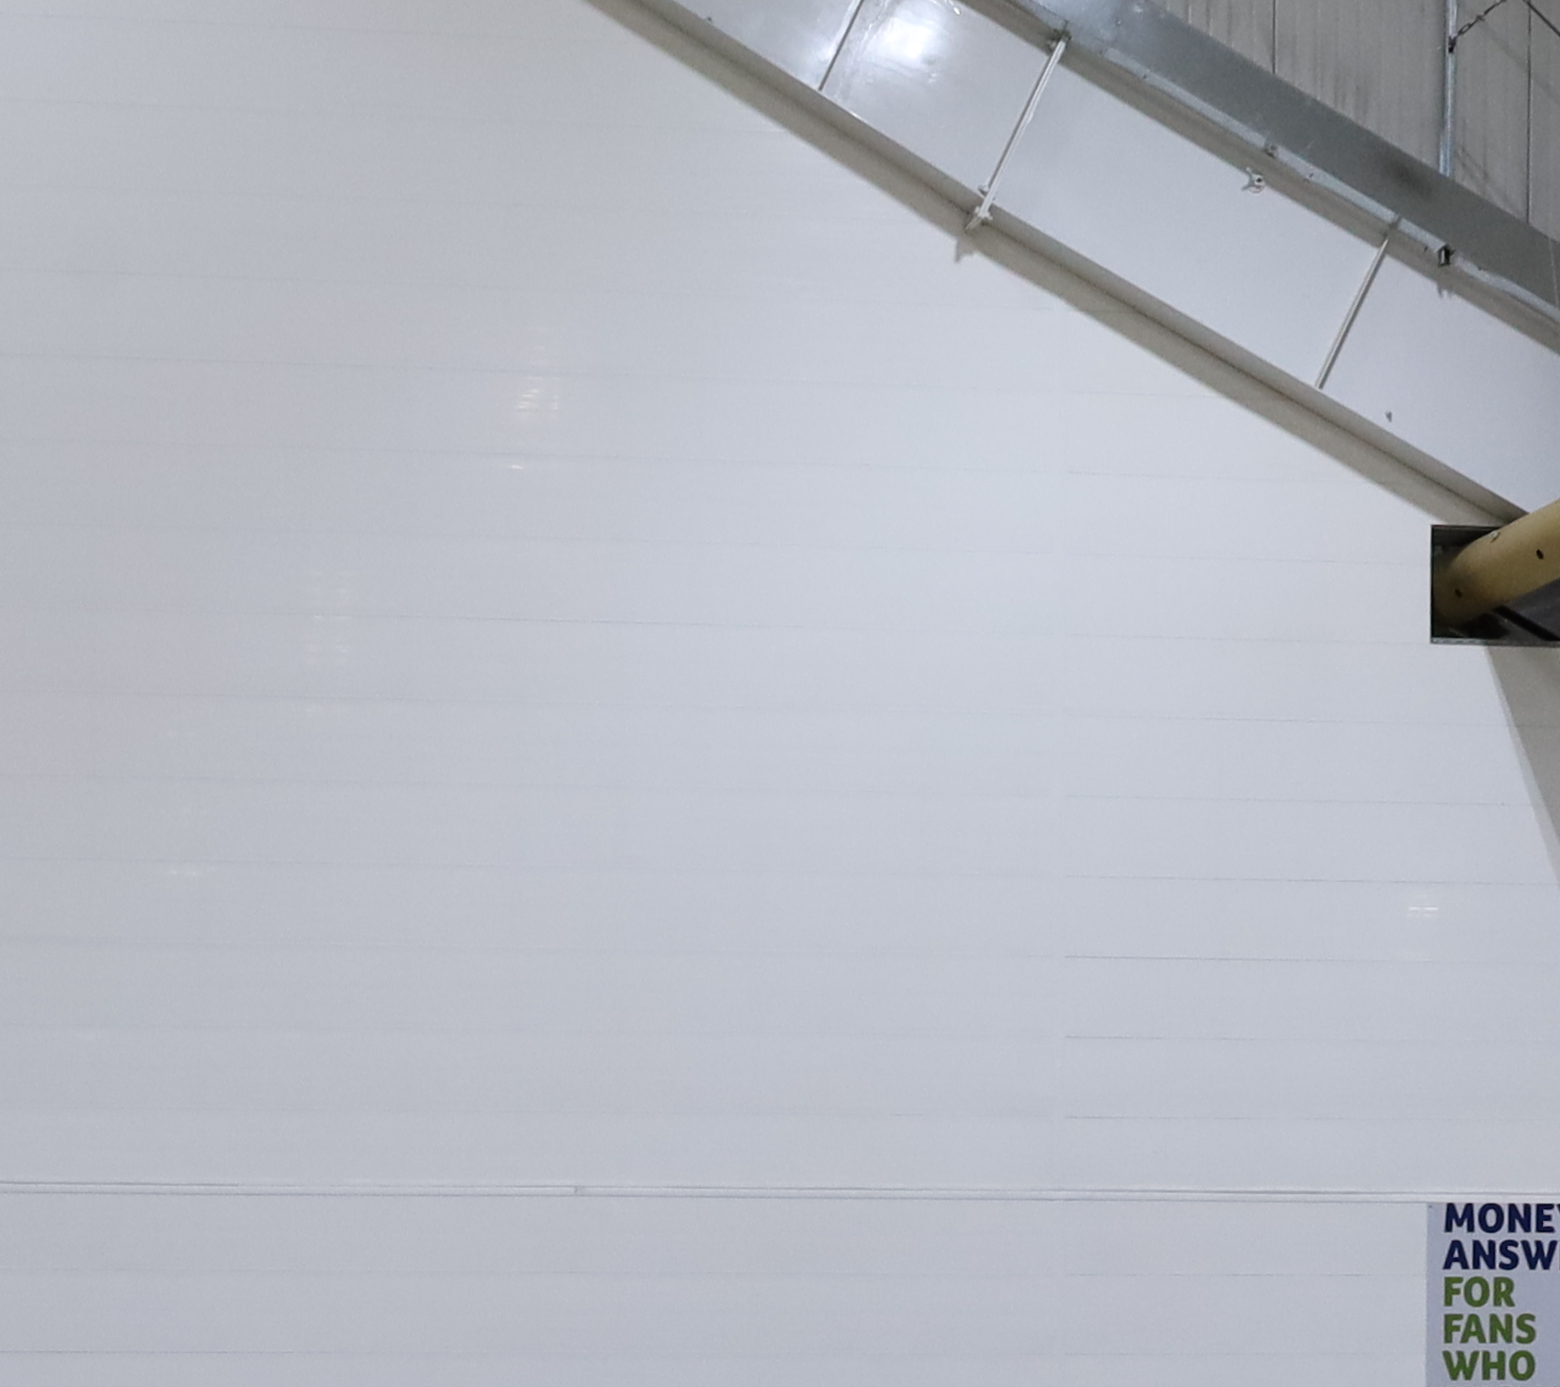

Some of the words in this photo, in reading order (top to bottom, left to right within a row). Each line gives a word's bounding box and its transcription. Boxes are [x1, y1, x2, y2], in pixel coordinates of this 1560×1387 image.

[1443, 1276, 1516, 1308] FOR
[1443, 1313, 1537, 1345] FANS
[1442, 1350, 1536, 1381] WHO
